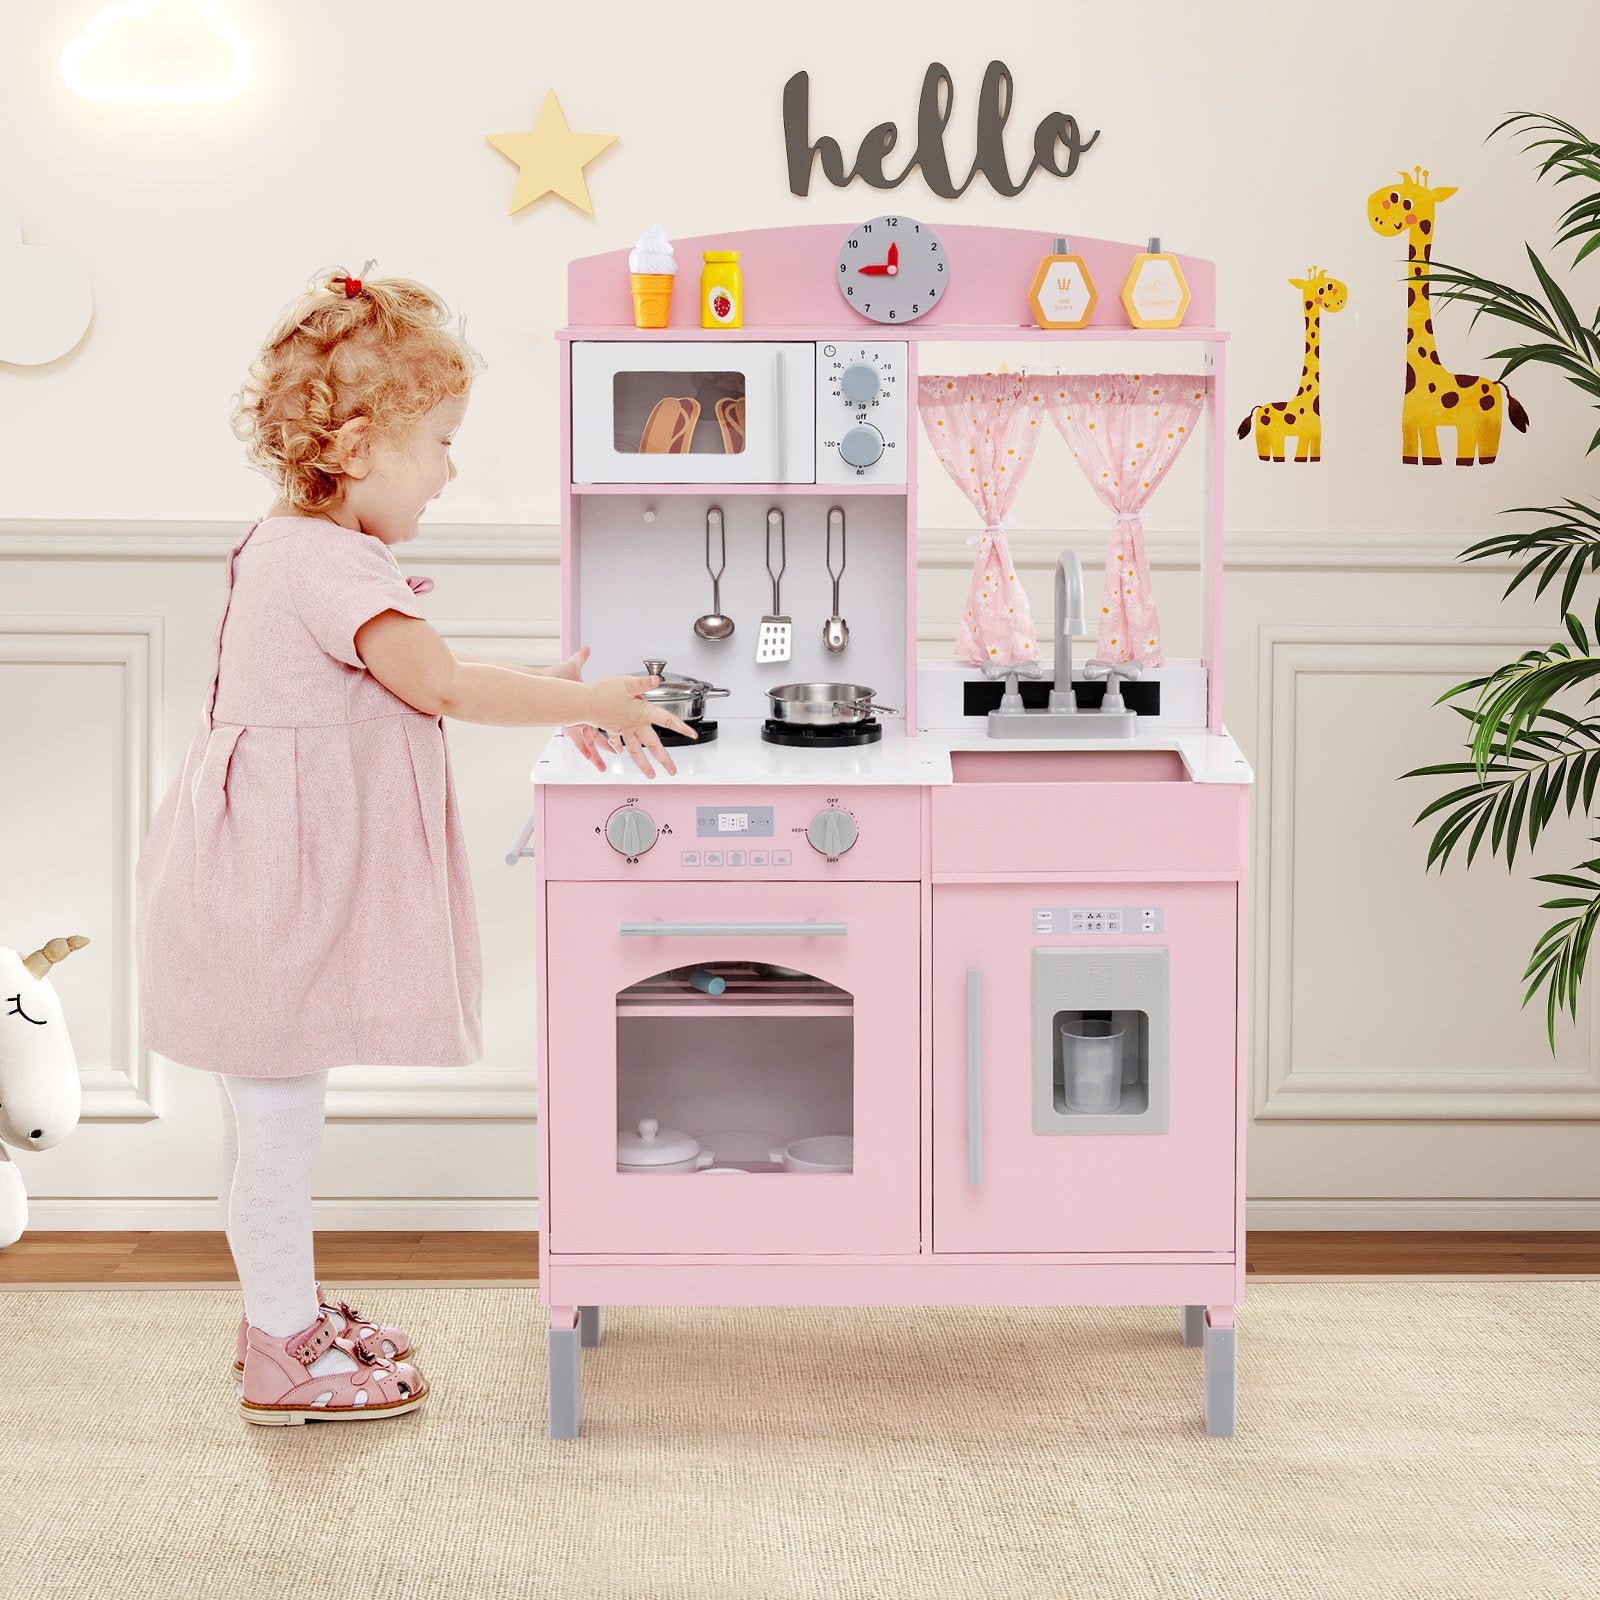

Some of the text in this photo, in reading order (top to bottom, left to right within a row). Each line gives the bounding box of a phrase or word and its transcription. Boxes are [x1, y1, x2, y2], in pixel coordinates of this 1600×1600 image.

[783, 60, 1100, 199] hello
[885, 218, 898, 227] 12
[863, 225, 872, 233] 11
[914, 225, 919, 234] 1
[847, 240, 859, 249] 10
[930, 243, 938, 252] 2
[840, 264, 847, 273] 9
[937, 263, 944, 273] 3
[847, 287, 854, 296] 8
[928, 289, 936, 297] 4
[864, 304, 871, 313] 7
[912, 305, 919, 314] 5
[889, 310, 896, 319] 6
[855, 413, 867, 421] off
